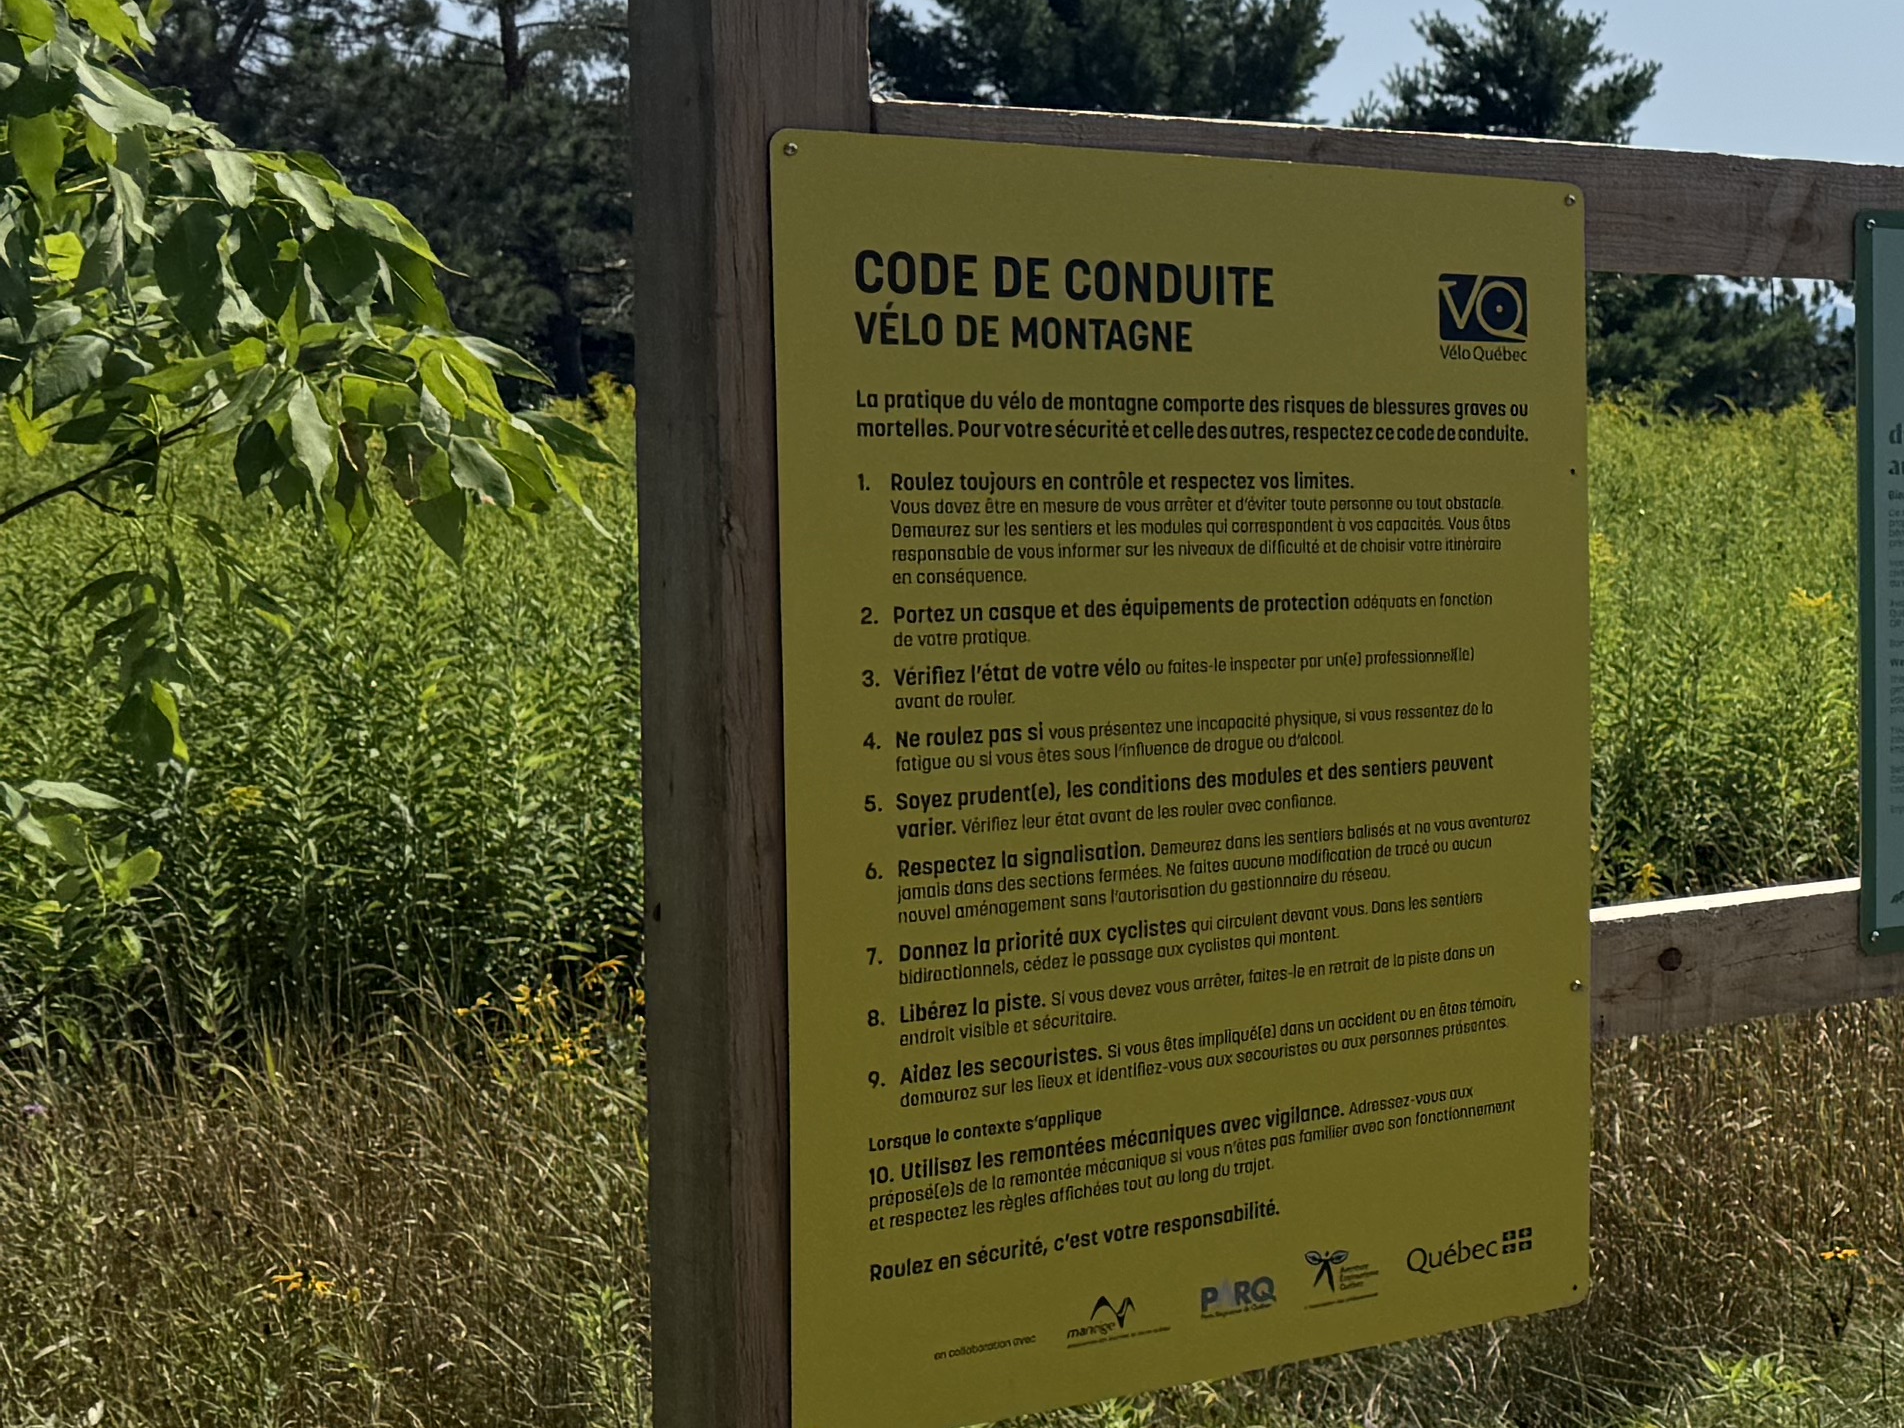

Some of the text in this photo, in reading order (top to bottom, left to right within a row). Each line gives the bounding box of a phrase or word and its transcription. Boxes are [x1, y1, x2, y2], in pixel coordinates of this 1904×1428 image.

[855, 249, 1274, 307] CODE DE CONDUITE
[854, 301, 1193, 353] VÉLO DE MONTAGNE
[1439, 344, 1527, 362] Vélo Québec
[856, 389, 1528, 420] La pratique du vélo de montagne comporte des risques de blessures graves ou
[857, 418, 1529, 444] mortelles. Pour votre sécurité et celle des autres, respectez ce code de conduite.
[858, 471, 1354, 495] 1. Roulez toujours en contrôle et respectez vos limites.
[892, 567, 1027, 587] en conséquence.
[861, 592, 1493, 625] 2. Portez un casque et des équipements de protection adéquats en fonction
[893, 628, 1030, 648] de votre pratique.
[862, 657, 1141, 688] 3. Vérifiez l'état de votre vélo
[895, 689, 1015, 710] avant de rouler.
[863, 721, 1043, 750] 4. Ne roulez pas si
[864, 754, 1494, 814] 5. Soyez prudent(e), les conditions des modules et des sentiers peuvent
[896, 817, 956, 840] varier.
[865, 840, 1145, 880] 6. Respectez la signalisation.
[866, 919, 1186, 966] 7. Donnez la priorité aux cyclistes
[867, 992, 1046, 1027] 8. Libérez la piste.
[868, 1047, 1102, 1089] 9. Aidez les secouristes.
[869, 1109, 1102, 1152] Lorsque le contexte s'applique
[869, 1104, 1345, 1185] 10. Utilisez les remontées mécaniques avec vigilance.
[870, 1198, 1280, 1282] Roulez en sécurité, c'est votre responsabilité.
[1406, 1239, 1498, 1274] Québec
